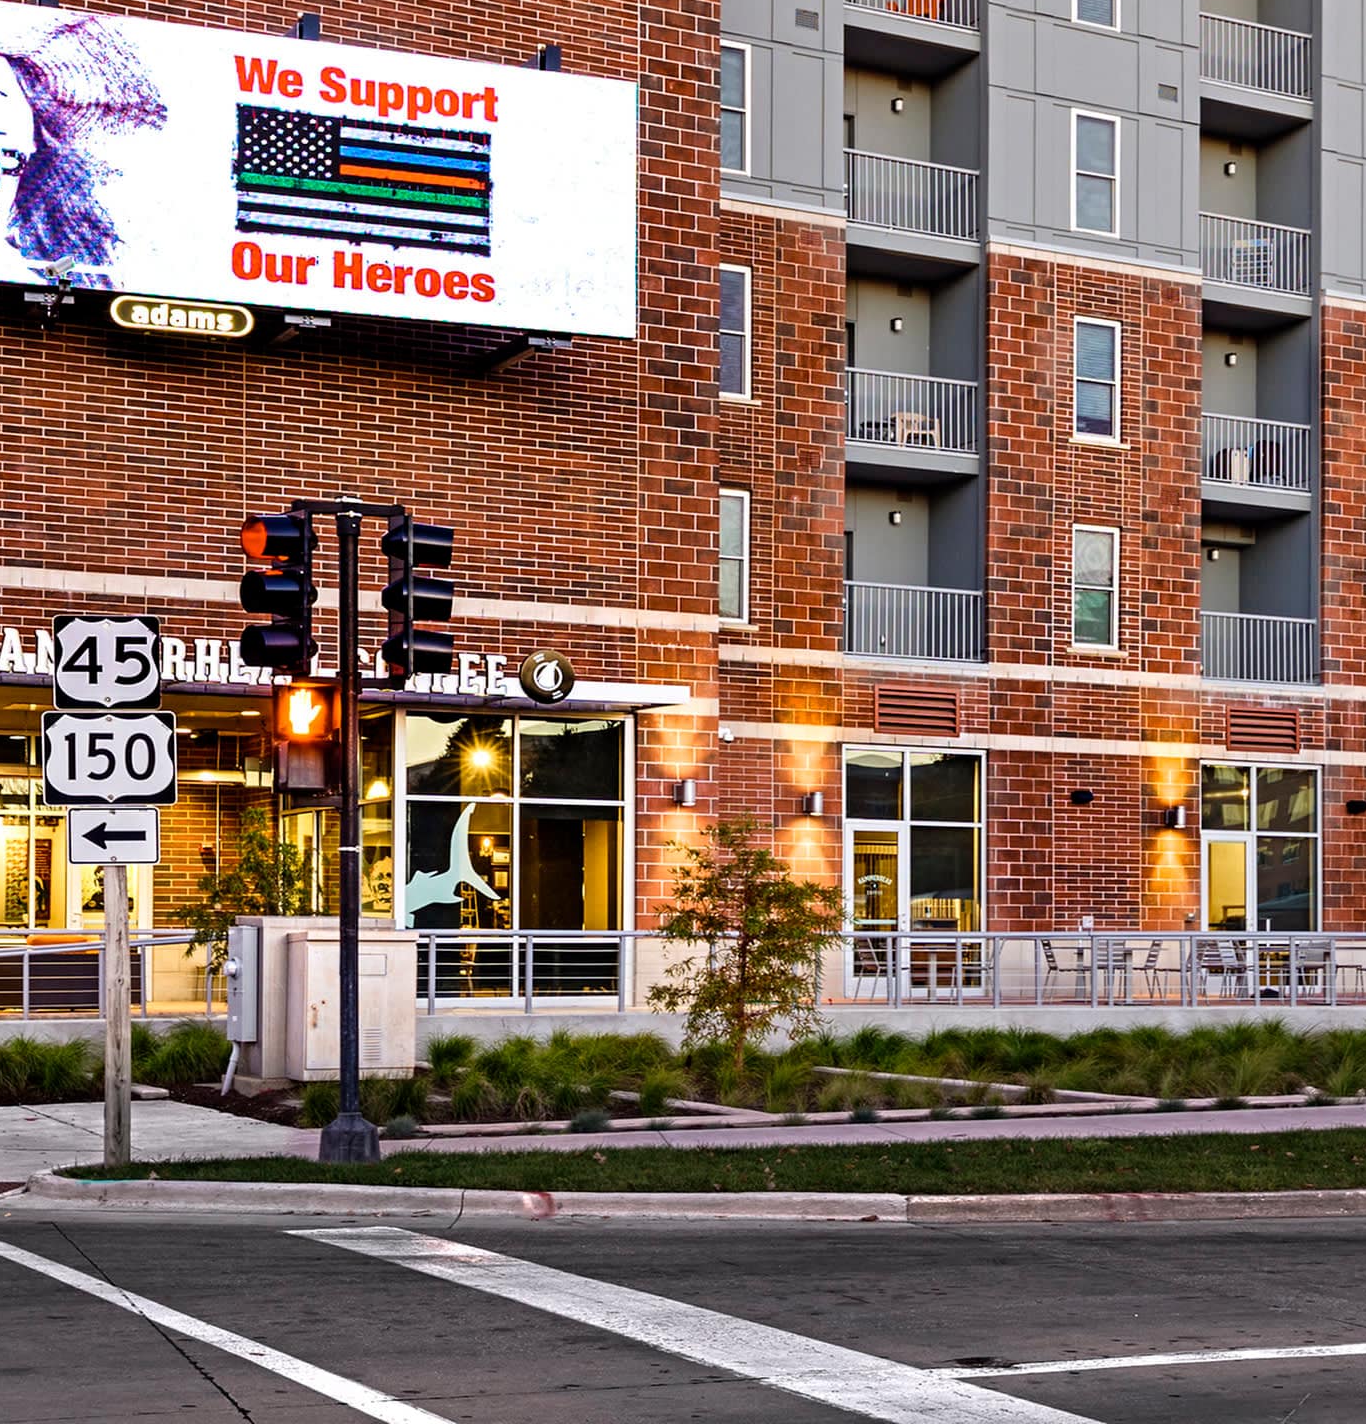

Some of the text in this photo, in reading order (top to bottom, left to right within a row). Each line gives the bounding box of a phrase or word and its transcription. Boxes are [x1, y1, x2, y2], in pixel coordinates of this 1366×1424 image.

[234, 54, 499, 123] We Support
[231, 241, 496, 303] Our Heroes
[130, 303, 234, 332] adams
[61, 635, 151, 686] 45
[64, 732, 156, 781] 150
